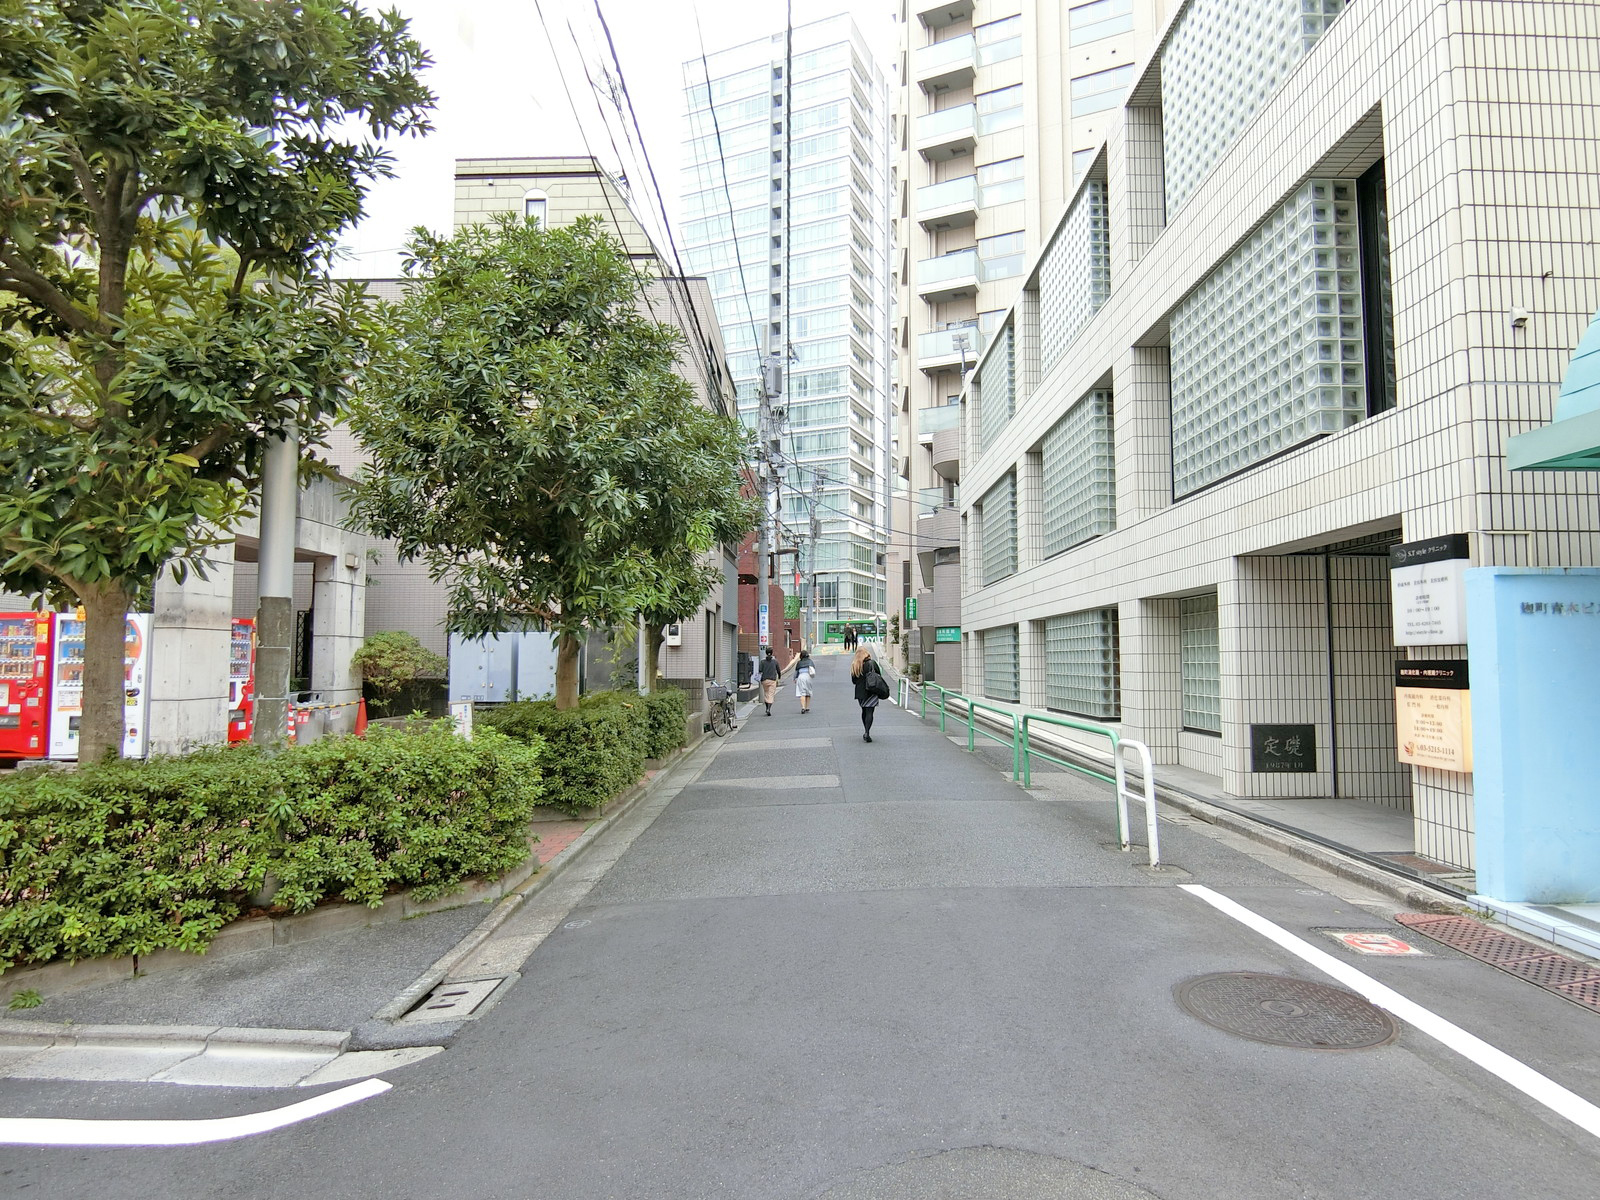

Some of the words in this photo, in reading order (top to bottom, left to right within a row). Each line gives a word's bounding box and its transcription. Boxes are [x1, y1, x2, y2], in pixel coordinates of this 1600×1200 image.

[1427, 544, 1448, 554] クリニック
[1264, 734, 1303, 756] 定礎
[1419, 744, 1455, 756] 03-5215-1114
